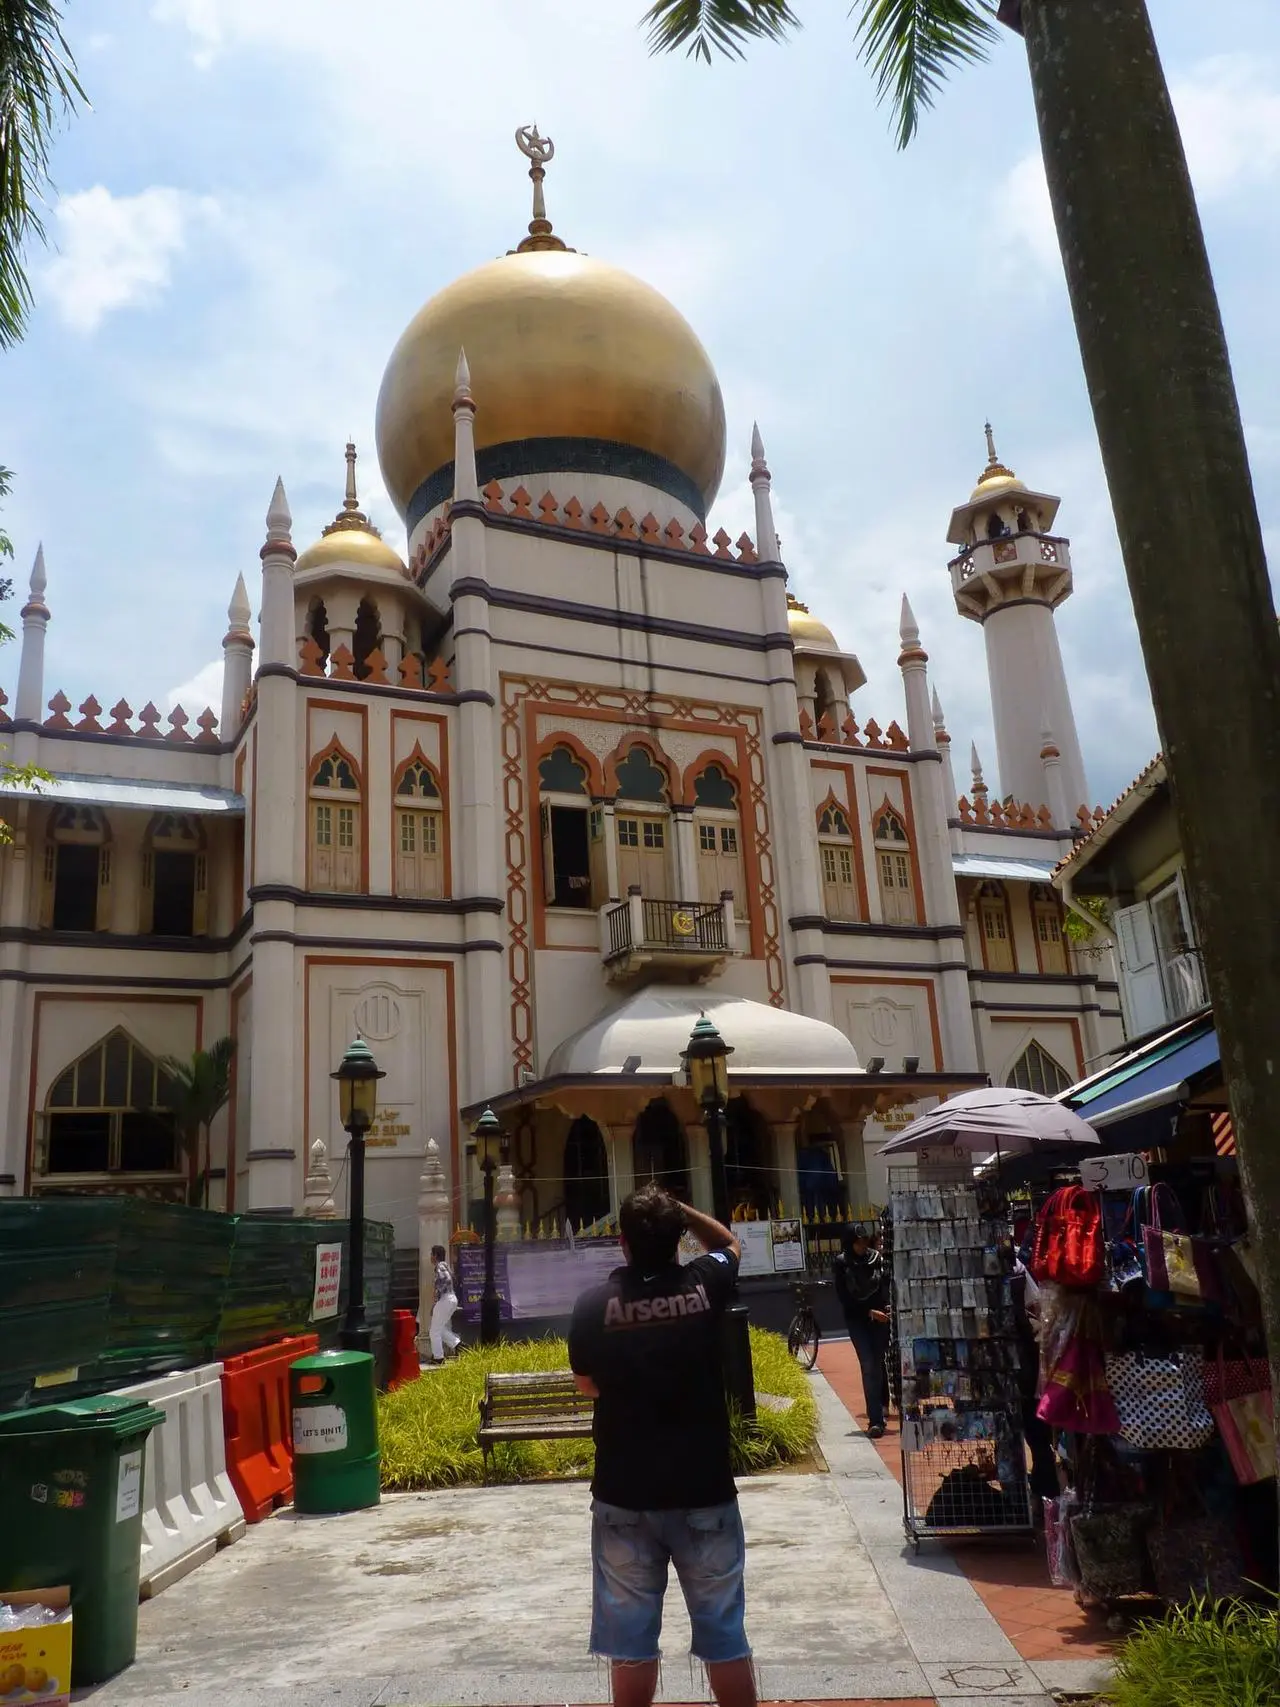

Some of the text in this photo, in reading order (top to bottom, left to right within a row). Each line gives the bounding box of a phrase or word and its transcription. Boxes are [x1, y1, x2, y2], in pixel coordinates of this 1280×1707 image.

[1090, 1161, 1109, 1182] 3
[604, 1284, 711, 1326] Arsenal
[320, 1427, 334, 1436] BIN
